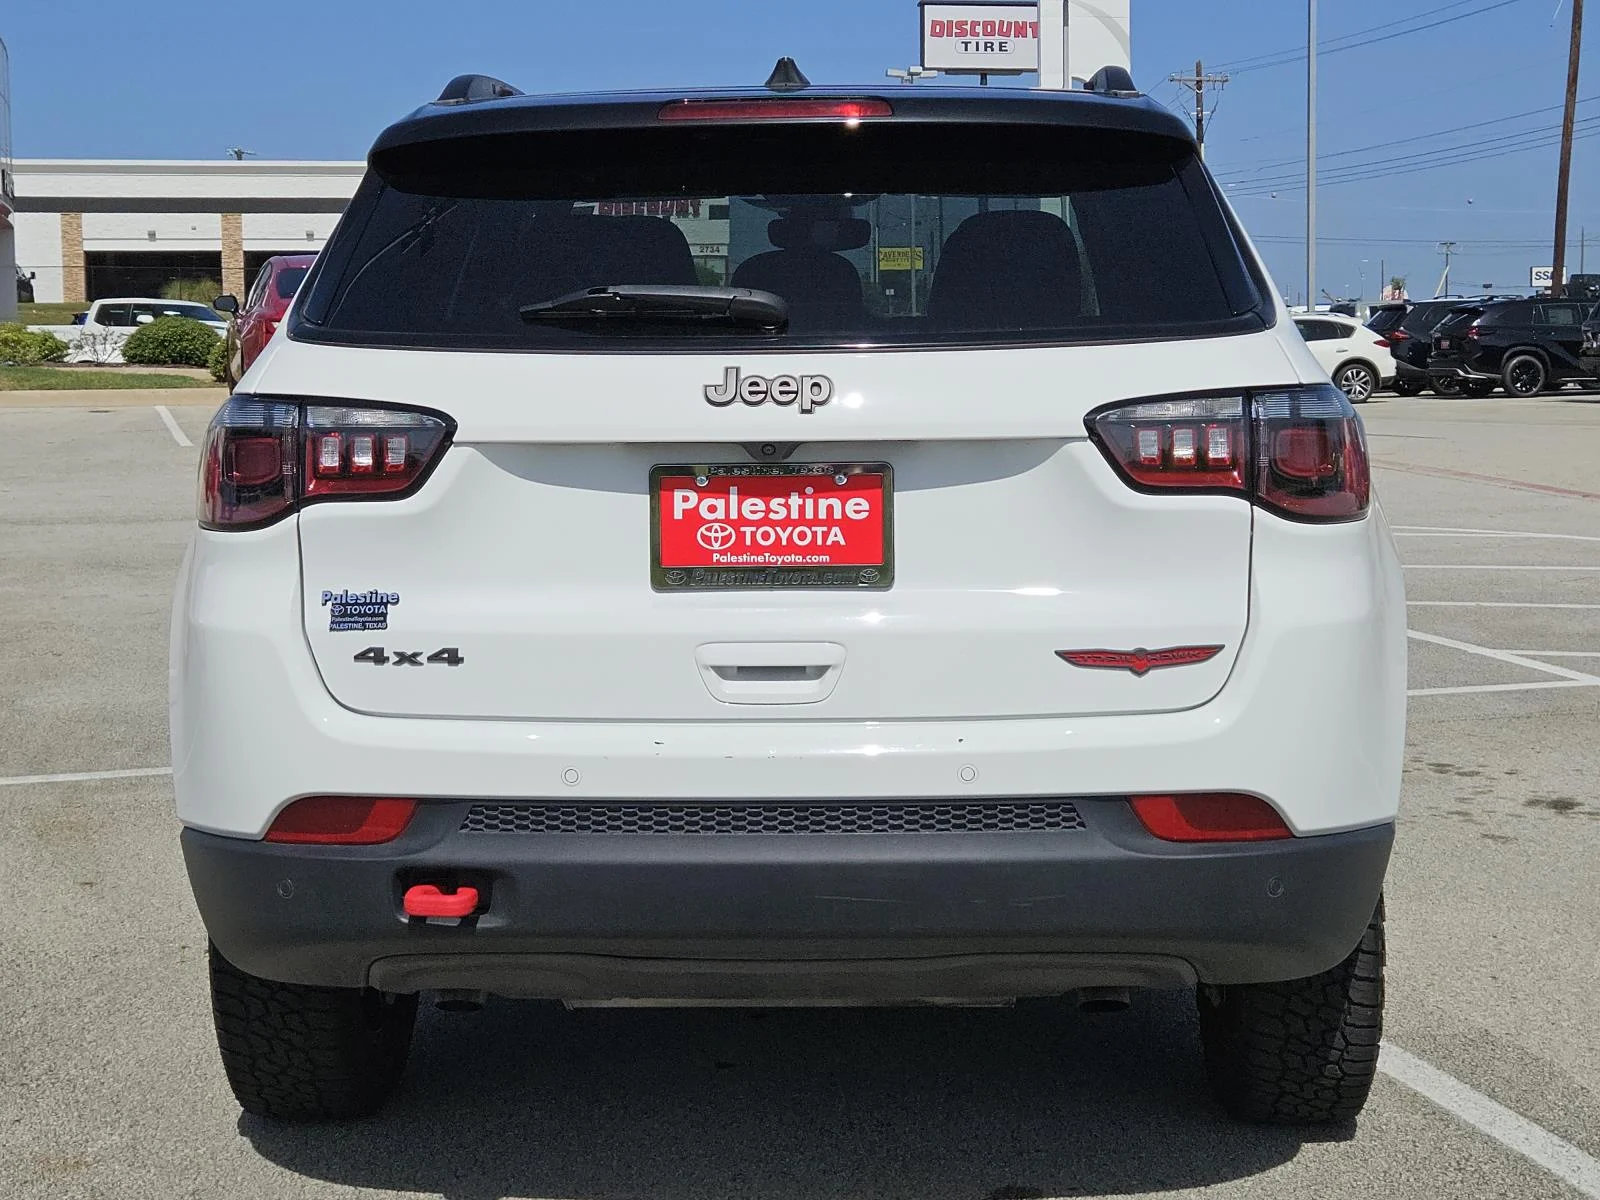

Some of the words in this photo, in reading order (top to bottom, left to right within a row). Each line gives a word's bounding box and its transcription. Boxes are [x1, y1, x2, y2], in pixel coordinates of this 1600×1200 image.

[930, 19, 1038, 38] DISCOUNT
[961, 41, 1009, 52] TIRE
[699, 245, 720, 254] 2734
[1534, 270, 1553, 281] SS
[703, 366, 834, 414] Jeep
[673, 486, 870, 520] Palestine
[740, 526, 846, 546] TOYOTA
[712, 552, 830, 565] PalestineToyota.com
[321, 589, 399, 606] Palestine
[346, 605, 387, 614] TOYOTA
[366, 622, 387, 630] TEXAS
[353, 646, 465, 667] 4x4
